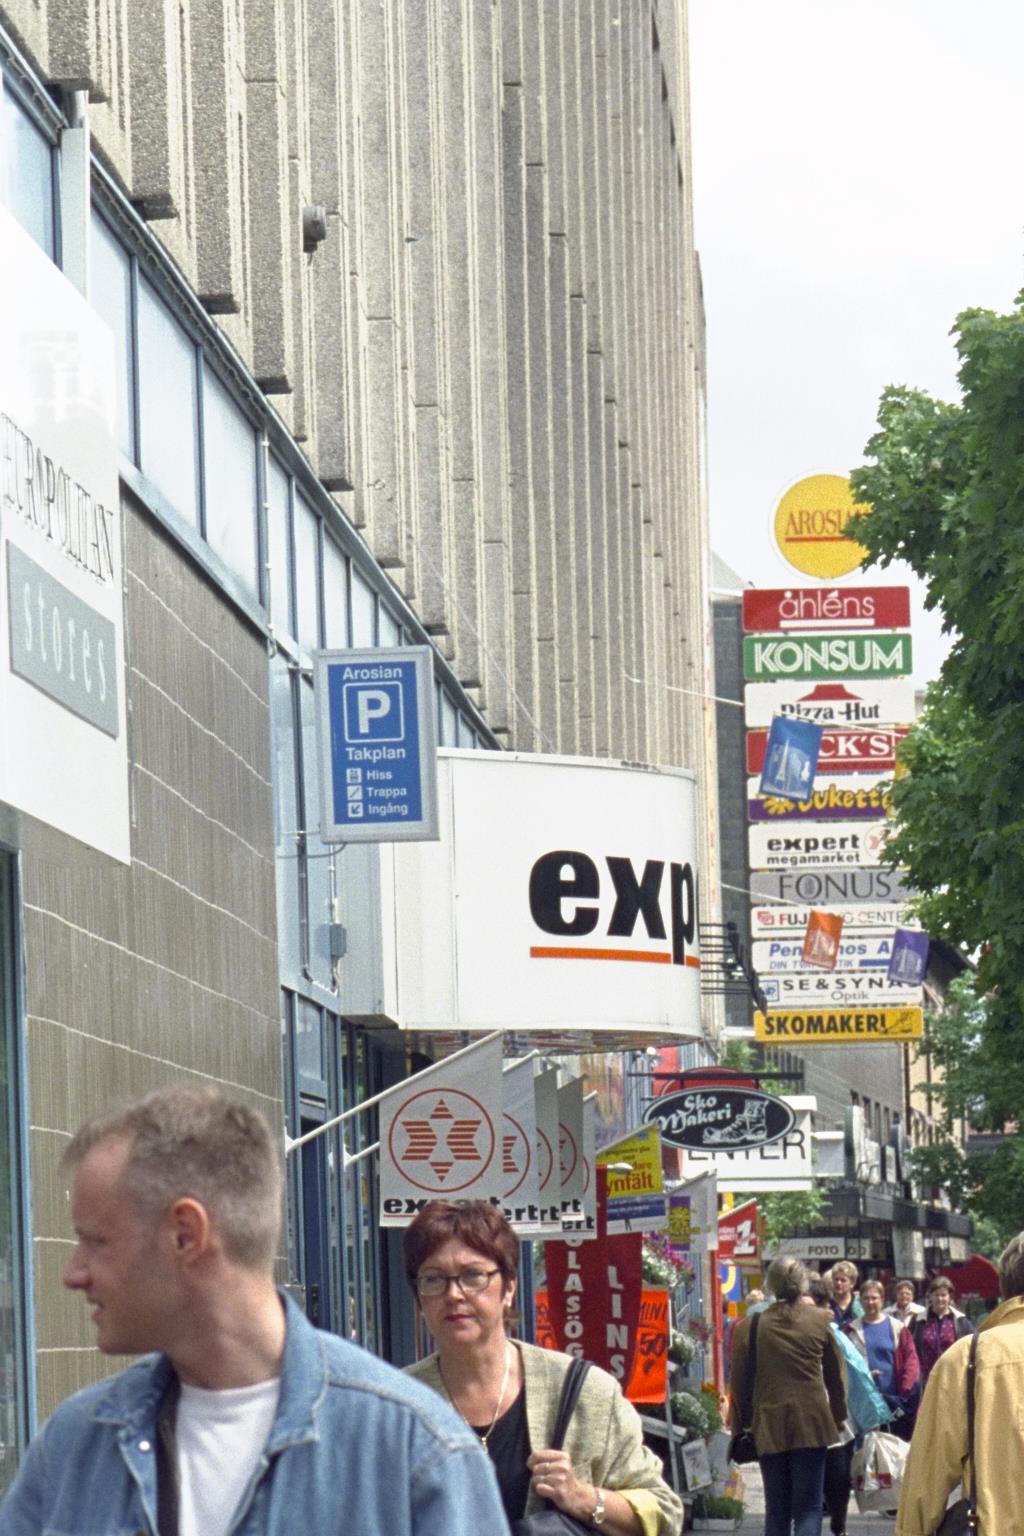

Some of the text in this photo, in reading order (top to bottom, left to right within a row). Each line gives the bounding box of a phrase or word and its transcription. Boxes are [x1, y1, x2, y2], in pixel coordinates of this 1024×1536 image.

[784, 509, 872, 536] AROSI
[23, 581, 107, 703] stores
[753, 639, 903, 673] KONSUM
[342, 666, 403, 680] Arosian
[357, 690, 392, 734] P
[779, 701, 880, 721] Pizza Hut
[345, 747, 406, 763] Takplan
[818, 734, 891, 758] CK'S
[366, 769, 393, 780] Hiss
[366, 786, 407, 799] Trappa
[367, 803, 409, 816] Ingång
[767, 833, 860, 853] expert
[767, 852, 860, 866] megamarket
[778, 873, 891, 899] FONUS
[528, 850, 695, 966] exp
[831, 990, 870, 1004] Optik
[684, 1095, 717, 1113] Sko
[657, 1103, 731, 1134] Makeri
[607, 1171, 655, 1197] ynfält
[808, 1245, 839, 1256] FOTO
